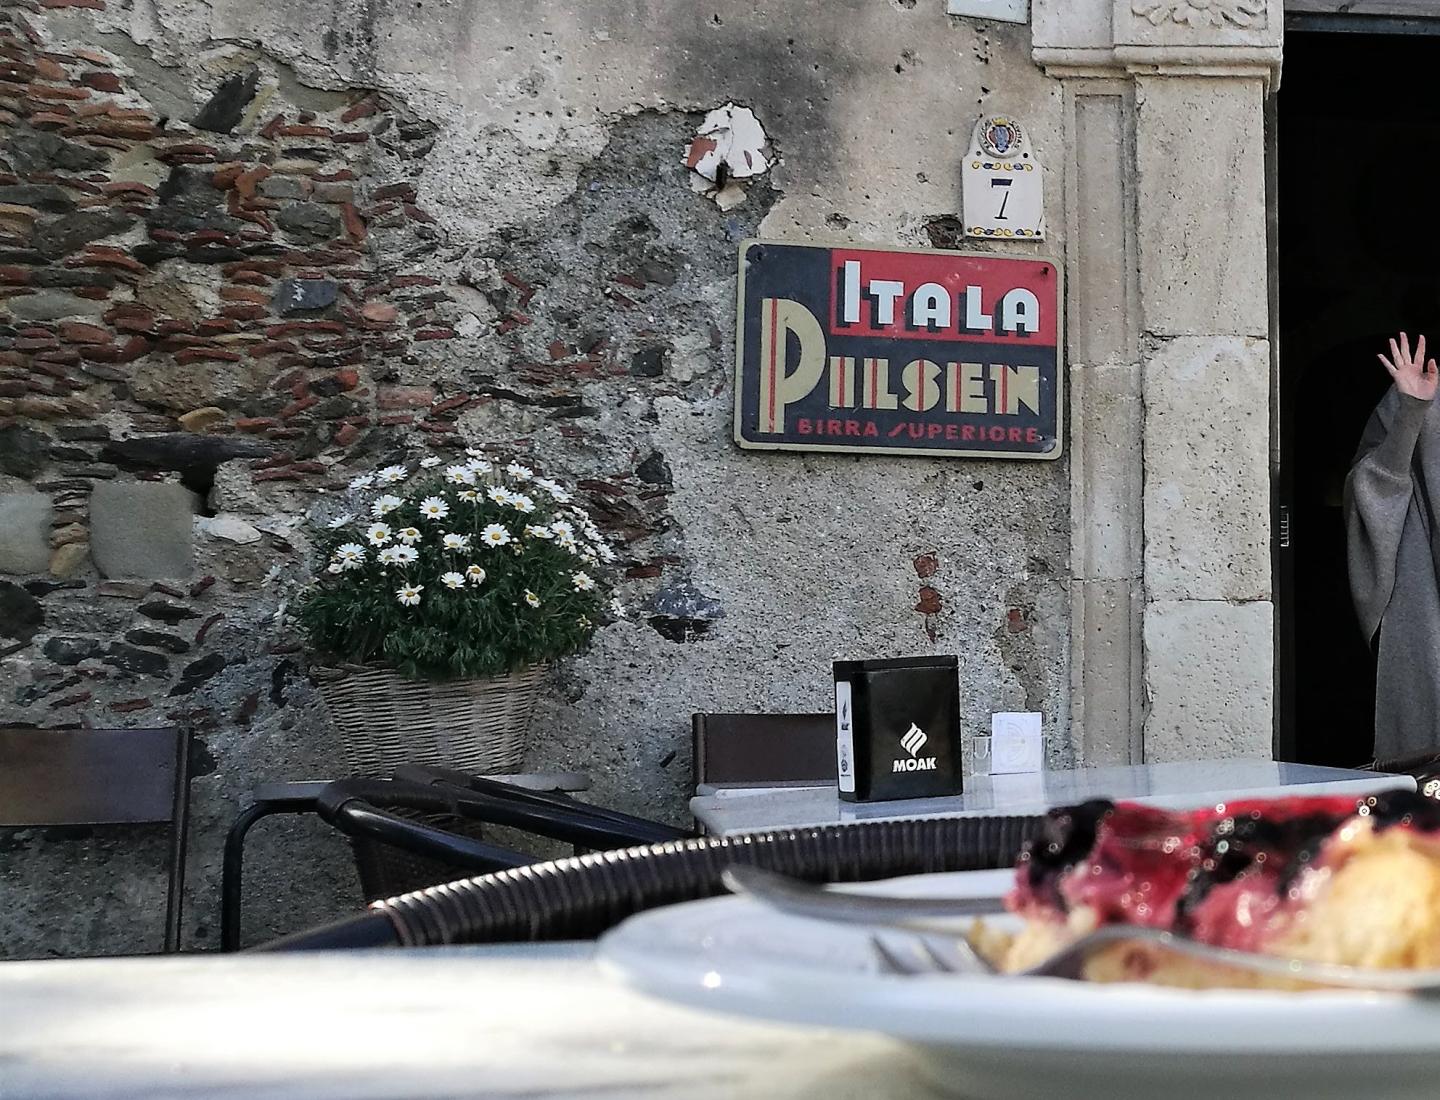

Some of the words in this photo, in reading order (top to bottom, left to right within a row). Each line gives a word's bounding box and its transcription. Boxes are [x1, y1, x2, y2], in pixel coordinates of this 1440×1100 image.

[990, 178, 1013, 220] 7
[843, 260, 1040, 333] ITALA
[758, 297, 1040, 434] PILSEN
[797, 418, 879, 438] BIRRA
[887, 422, 1040, 444] SUPERIORE
[892, 757, 938, 773] MOAK
